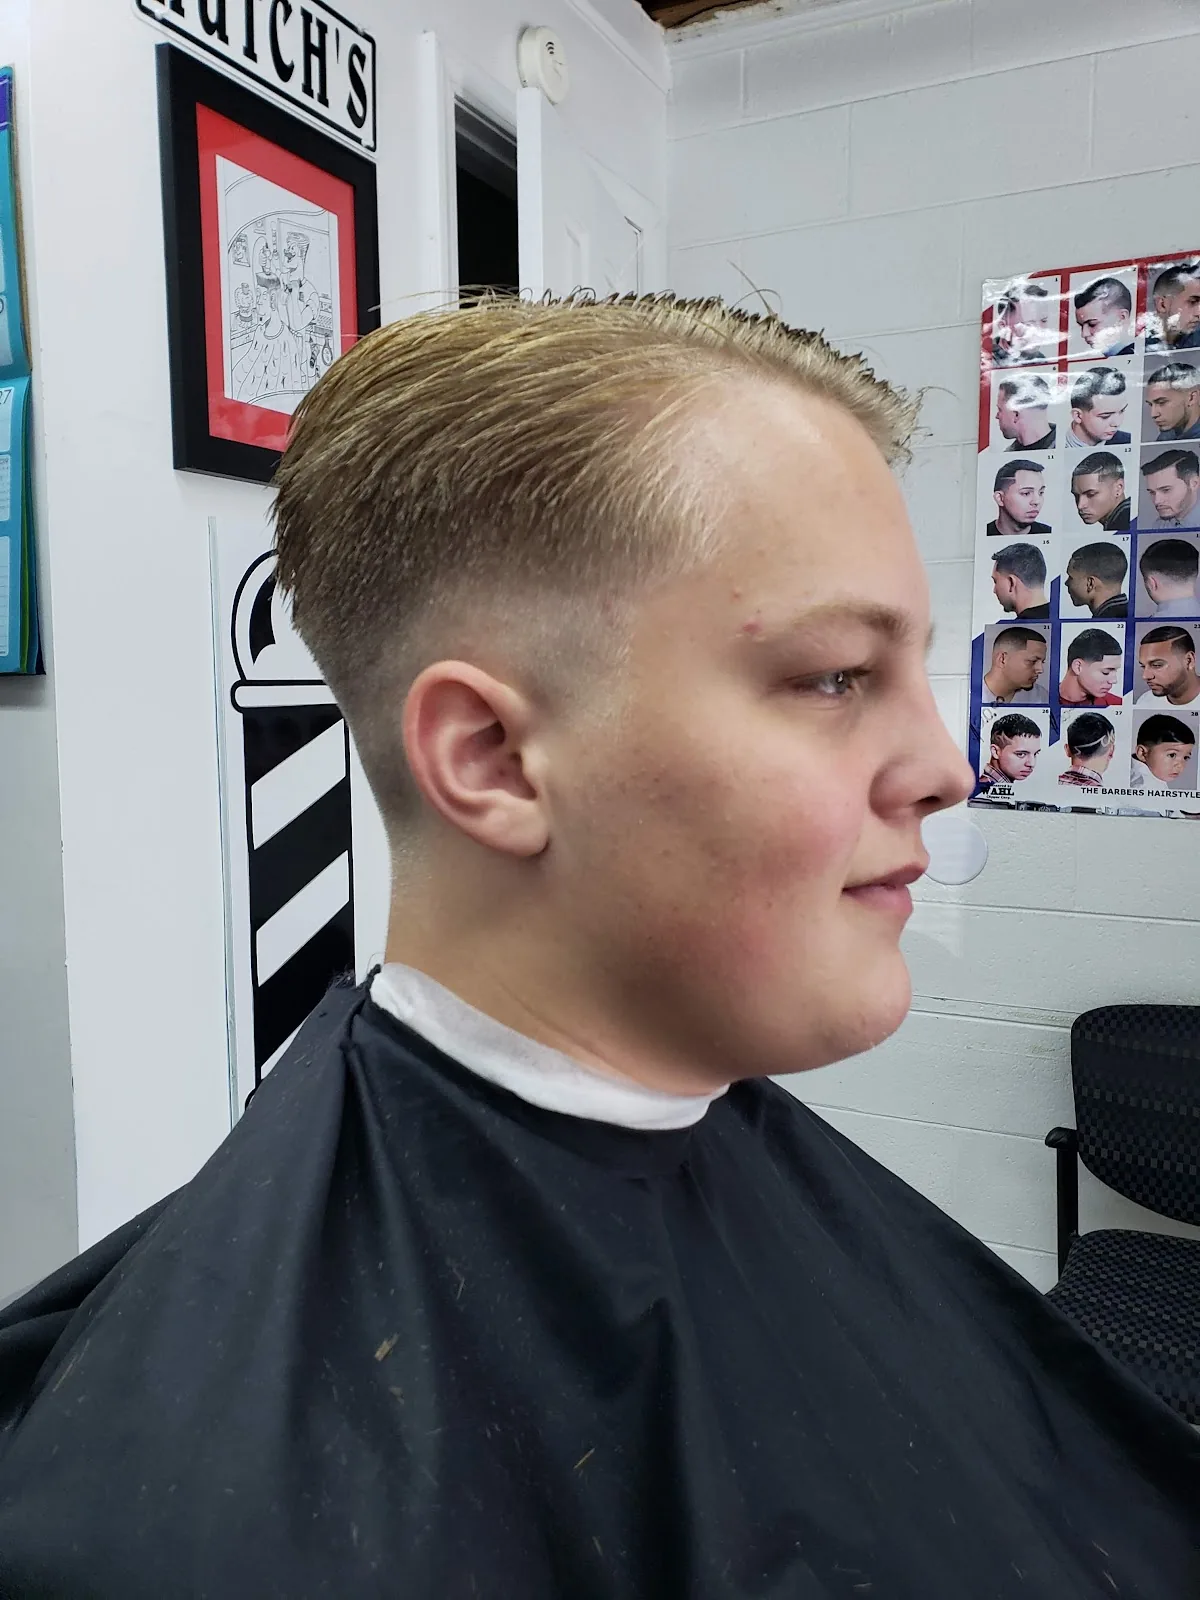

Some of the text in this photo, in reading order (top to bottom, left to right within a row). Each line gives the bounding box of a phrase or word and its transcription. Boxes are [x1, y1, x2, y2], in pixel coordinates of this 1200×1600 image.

[152, 0, 367, 128] UTCH'S
[981, 787, 1014, 796] WAHL
[1101, 788, 1145, 797] BARBERS
[1147, 790, 1200, 799] HAIRSTYLE
